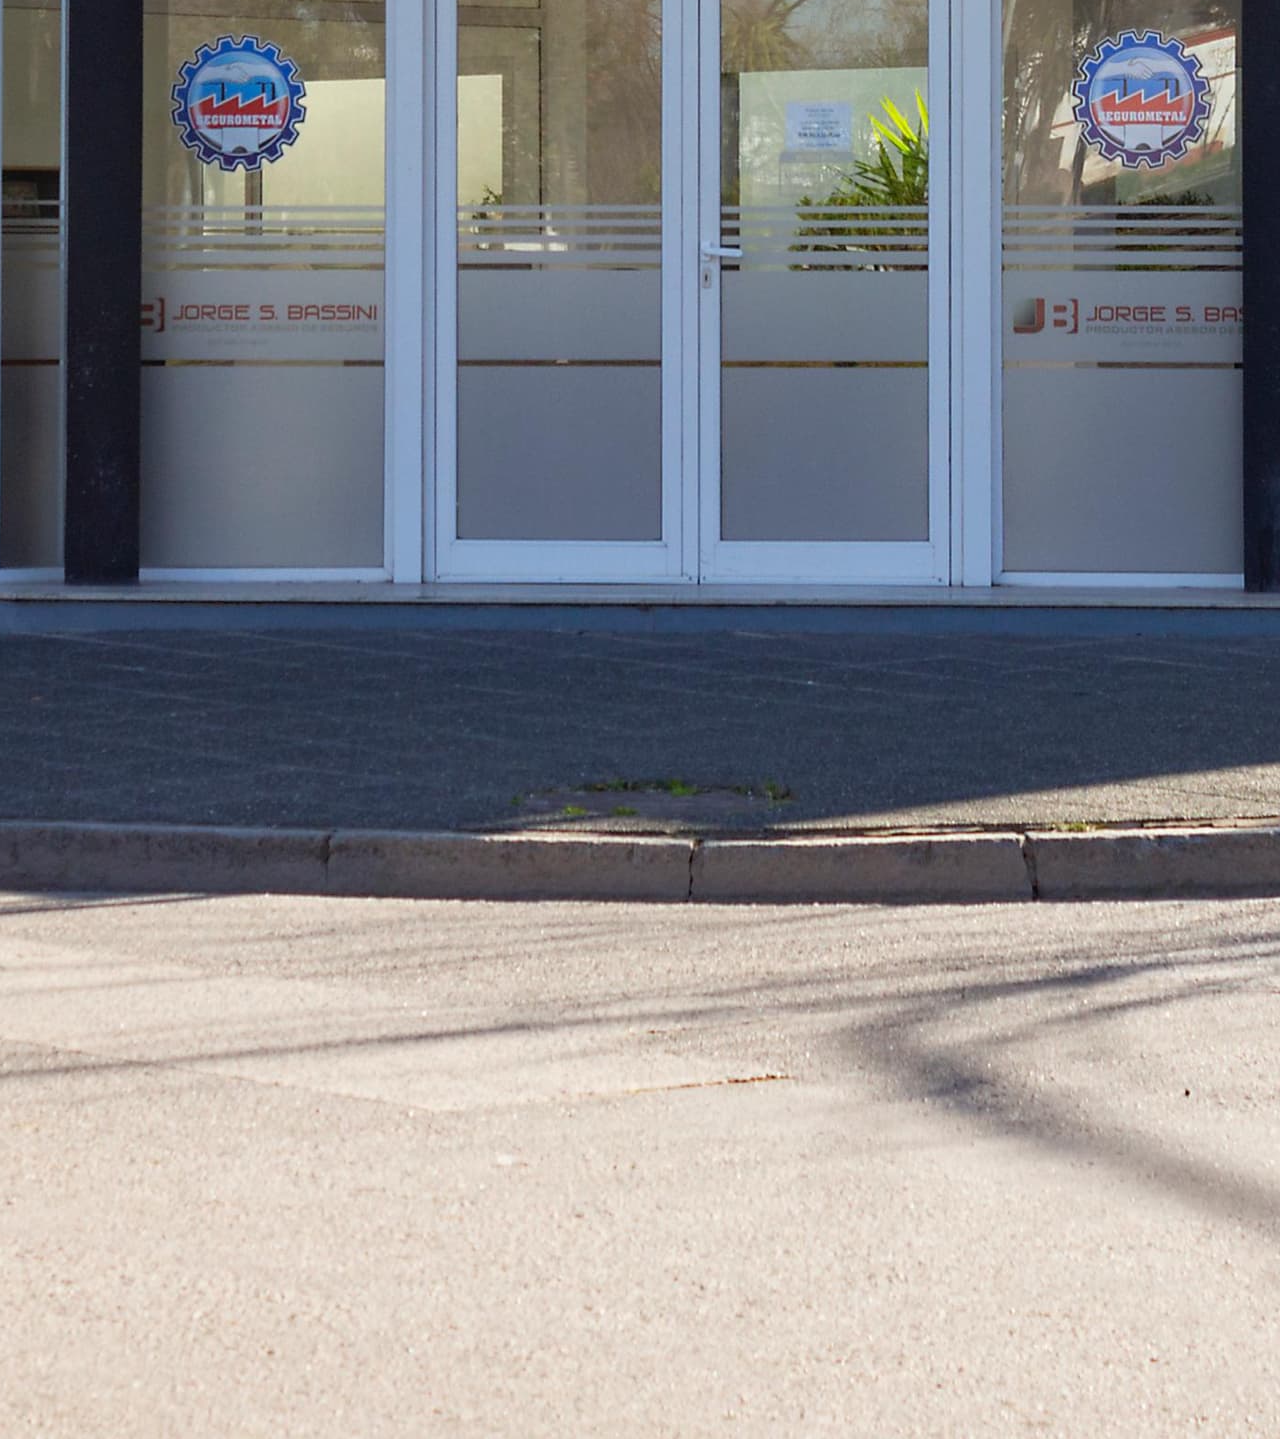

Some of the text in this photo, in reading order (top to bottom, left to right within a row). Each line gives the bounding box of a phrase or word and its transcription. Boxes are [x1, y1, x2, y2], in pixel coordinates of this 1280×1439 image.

[173, 304, 377, 320] JORGE S. BASSINI
[1086, 306, 1166, 322] JORGE
[1175, 306, 1195, 322] S.
